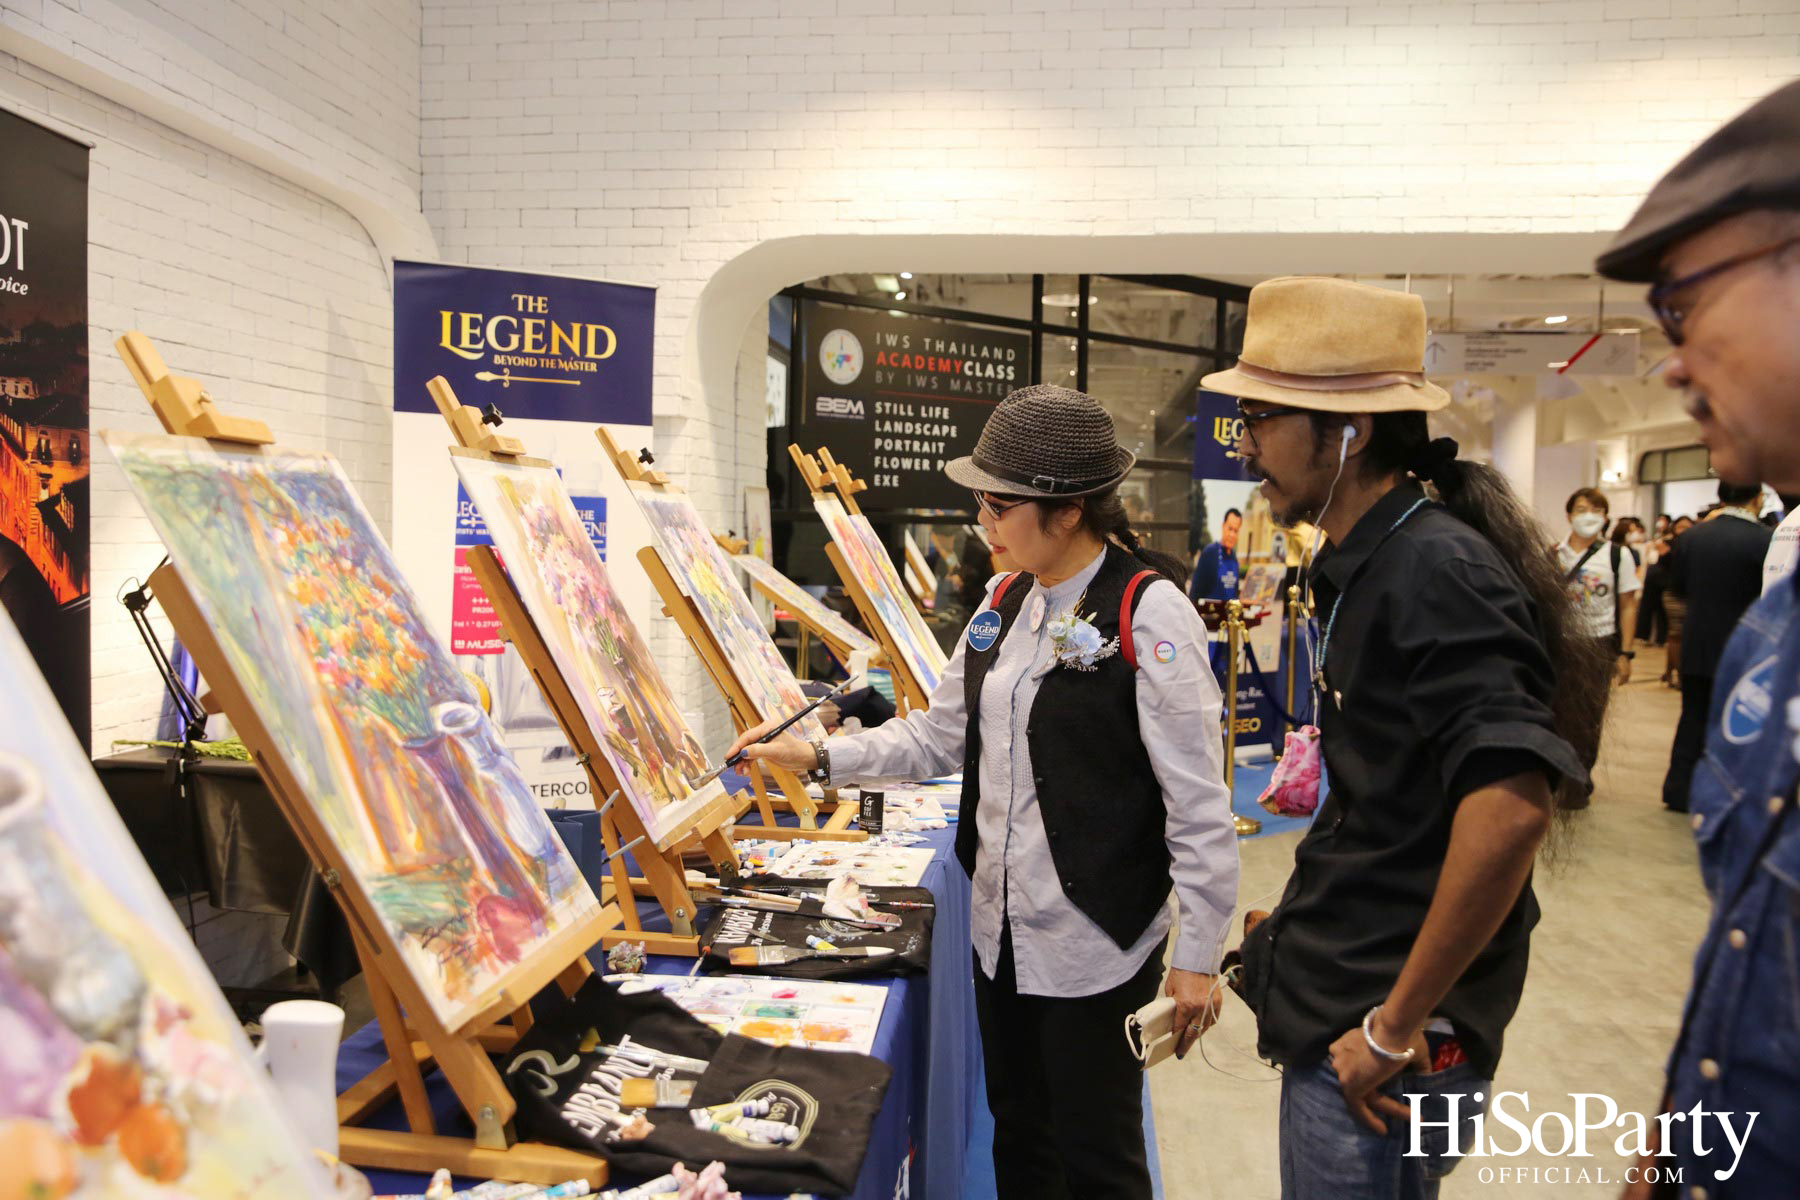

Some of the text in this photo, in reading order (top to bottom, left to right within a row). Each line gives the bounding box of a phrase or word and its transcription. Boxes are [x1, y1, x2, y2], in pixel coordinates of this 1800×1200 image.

[511, 293, 549, 314] THE
[439, 310, 617, 361] LEGEND
[876, 332, 1016, 361] IWS THAILAND
[494, 354, 537, 368] BEYOND
[539, 358, 557, 369] THE
[875, 371, 896, 384] BY
[907, 376, 938, 389] IWS
[816, 397, 865, 415] BEM
[875, 402, 914, 416] STILL
[921, 405, 950, 419] LIFE
[875, 419, 957, 438] LANDSCAPE
[1214, 417, 1246, 447] LEG
[874, 438, 945, 454] PORTRAIT
[874, 456, 930, 471] FLOWER
[874, 474, 899, 487] EXE
[970, 624, 1000, 635] LEGEND
[466, 640, 504, 649] MUSE
[530, 782, 592, 798] TERCO
